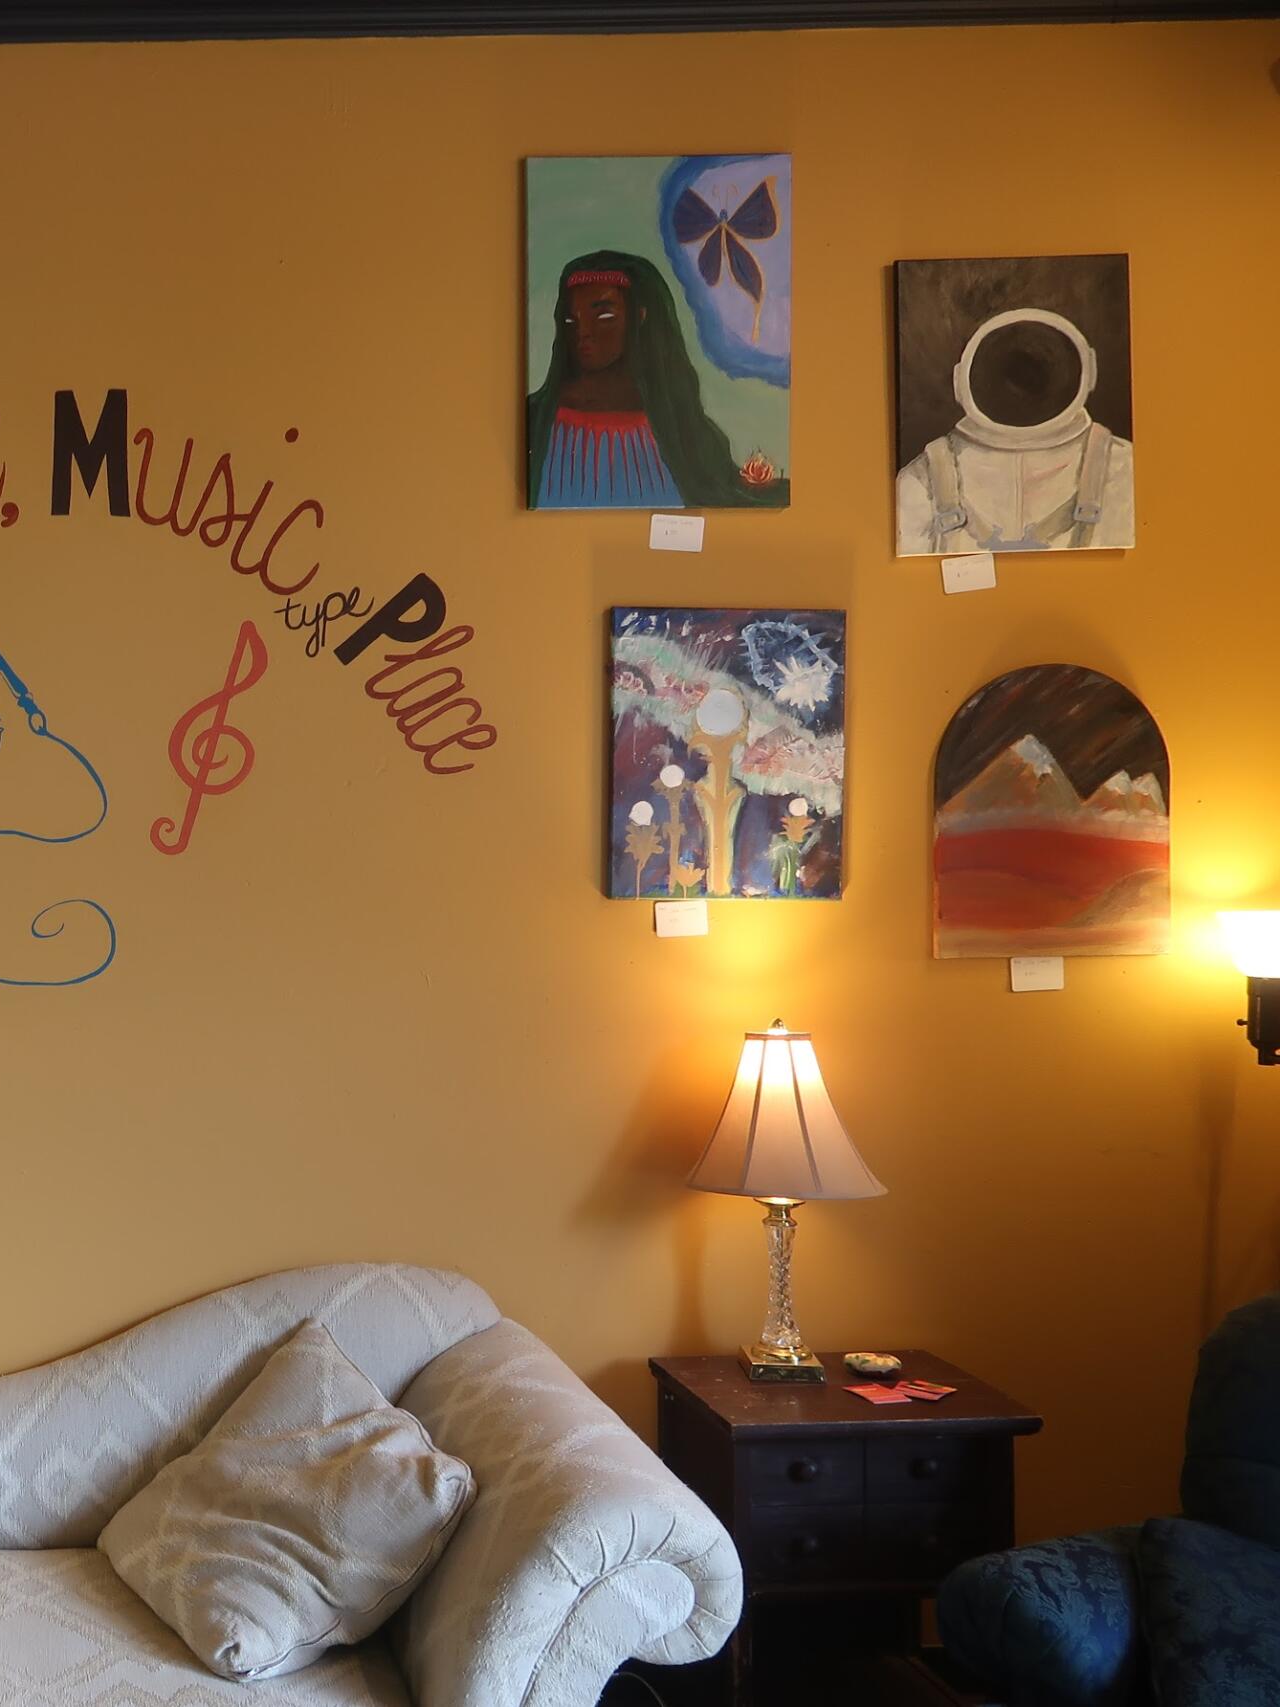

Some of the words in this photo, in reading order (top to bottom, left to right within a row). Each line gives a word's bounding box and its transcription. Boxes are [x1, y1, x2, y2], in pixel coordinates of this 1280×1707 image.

[51, 388, 324, 595] Music
[274, 586, 374, 657] type
[333, 572, 497, 775] Place
